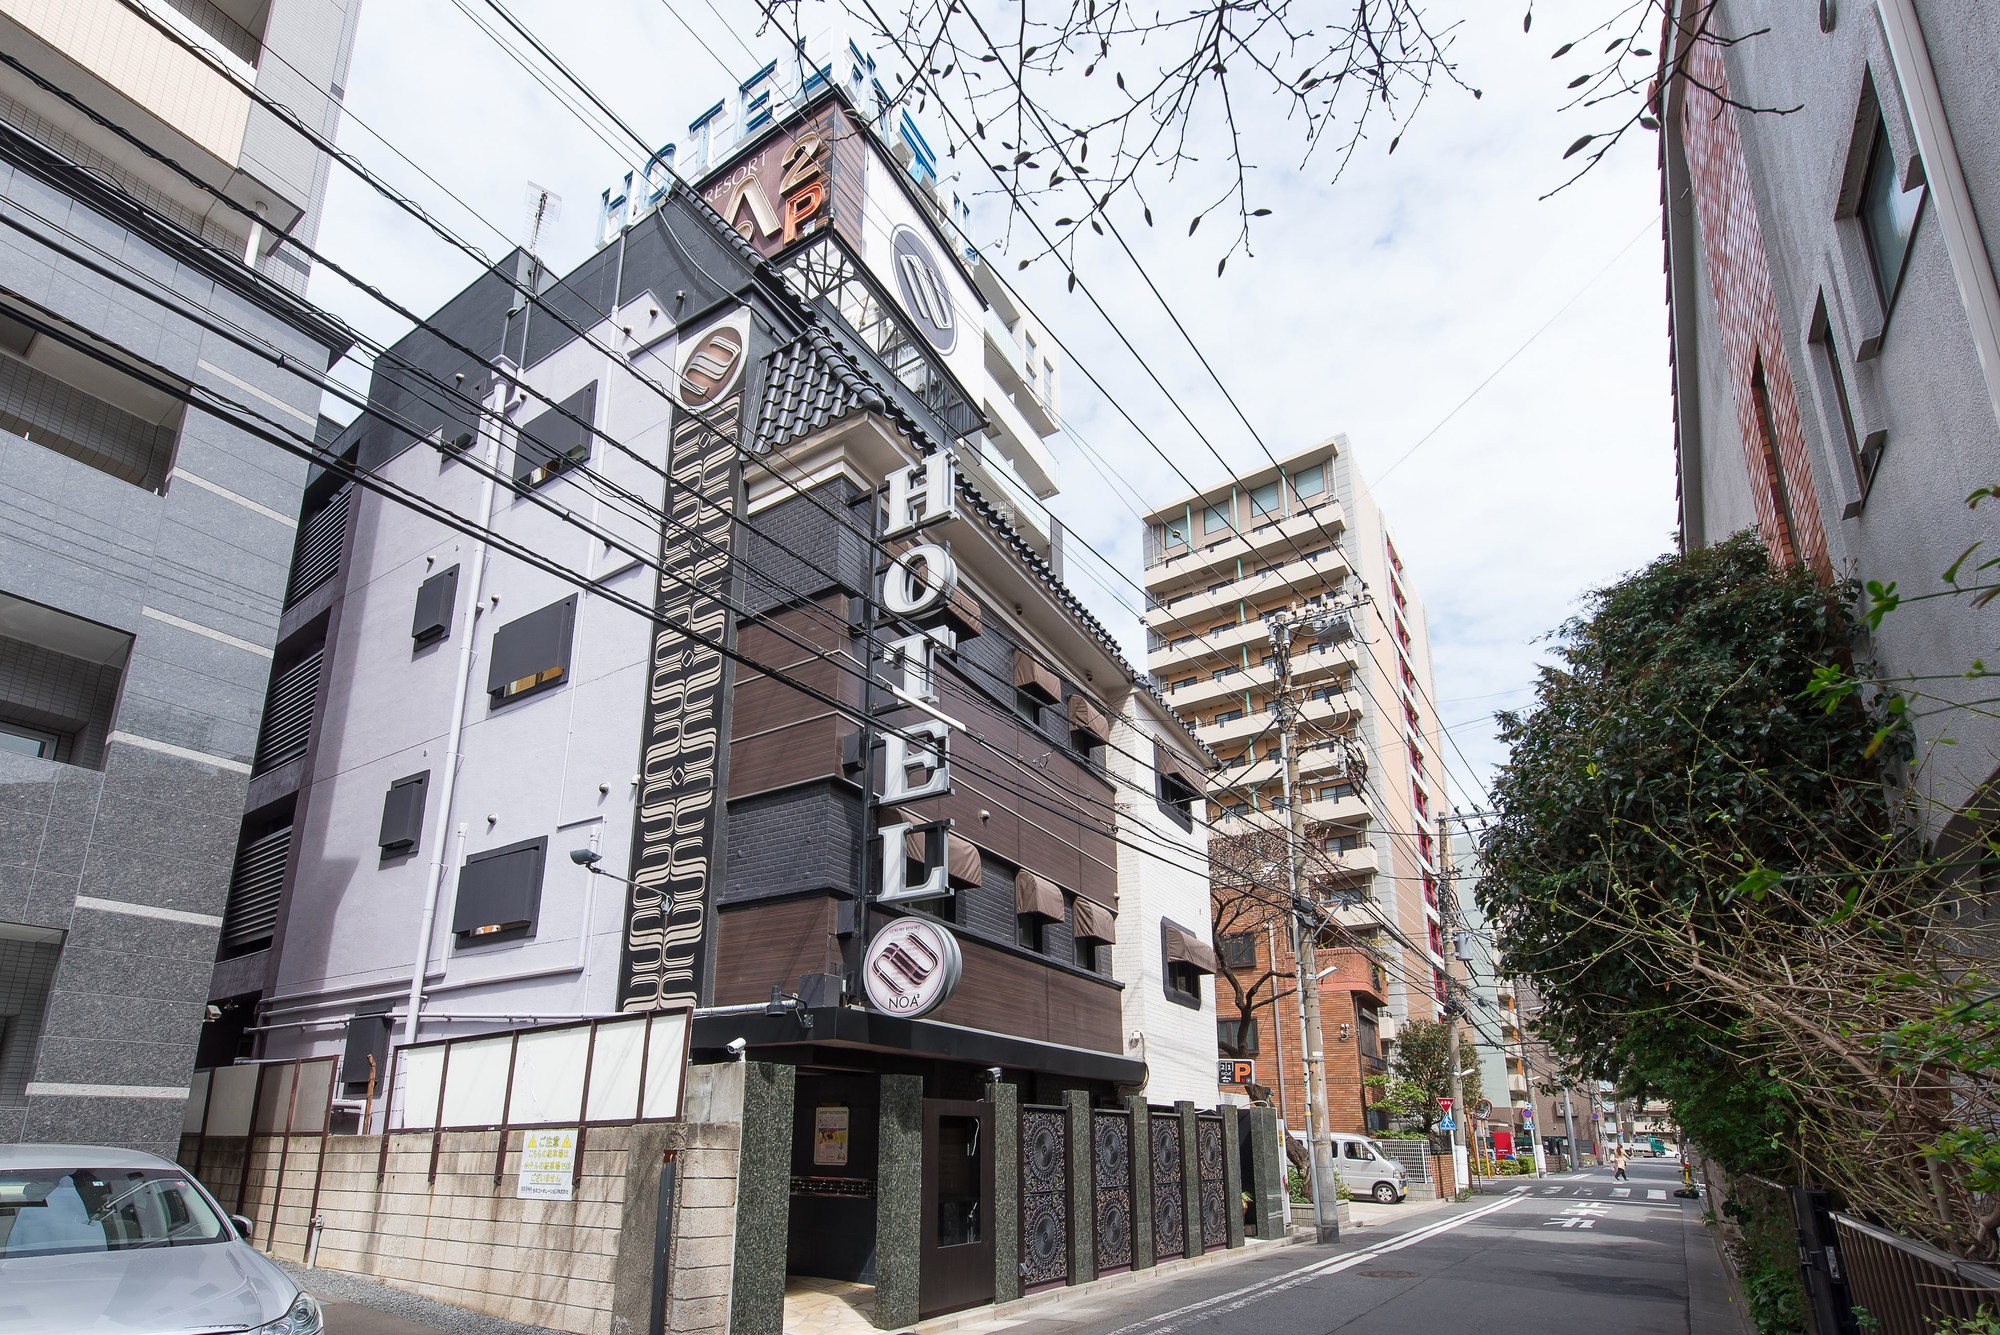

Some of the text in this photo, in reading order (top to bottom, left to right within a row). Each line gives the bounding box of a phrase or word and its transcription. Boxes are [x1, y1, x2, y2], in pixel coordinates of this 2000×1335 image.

[594, 34, 833, 249] HOTEL
[704, 147, 770, 203] RESORT
[877, 450, 957, 904] HOTEL
[1235, 1063, 1250, 1083] P
[539, 1136, 560, 1148] ご注意
[531, 1173, 561, 1183] ございません
